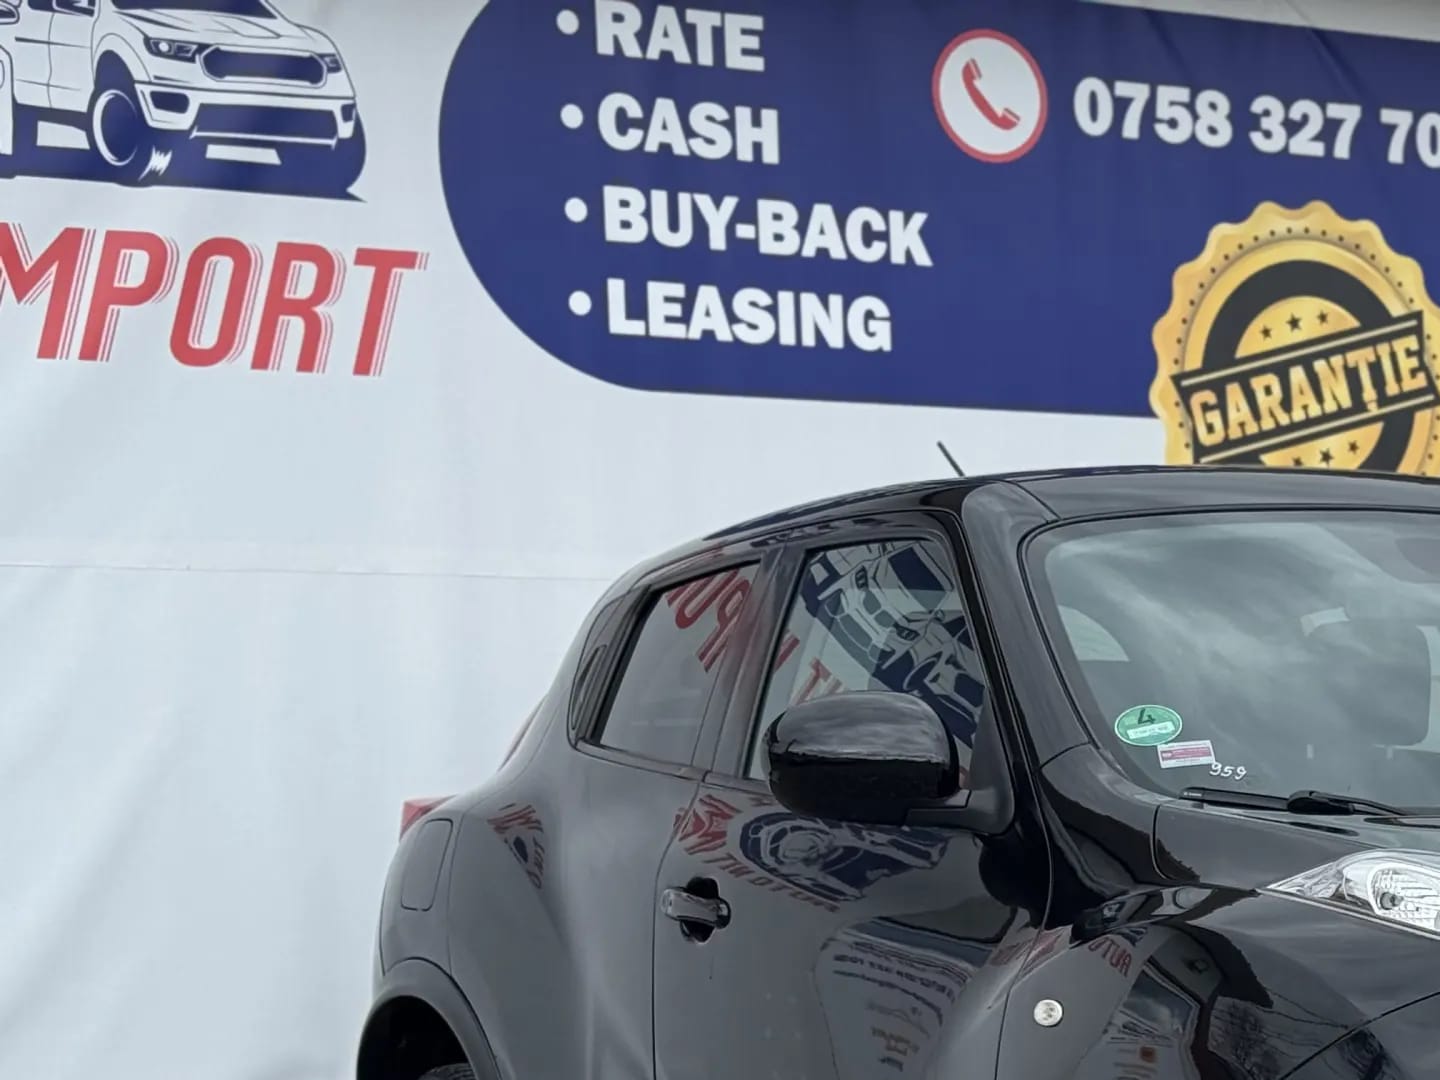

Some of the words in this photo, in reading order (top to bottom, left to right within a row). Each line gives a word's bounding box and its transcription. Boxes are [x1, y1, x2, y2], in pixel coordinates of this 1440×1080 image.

[595, 0, 765, 72] RATE
[598, 92, 780, 165] CASH
[1073, 77, 1233, 147] 0758
[1249, 96, 1362, 158] 327
[603, 185, 934, 267] BUY-BACK
[607, 278, 892, 352] LEASING
[1209, 761, 1248, 780] 959
